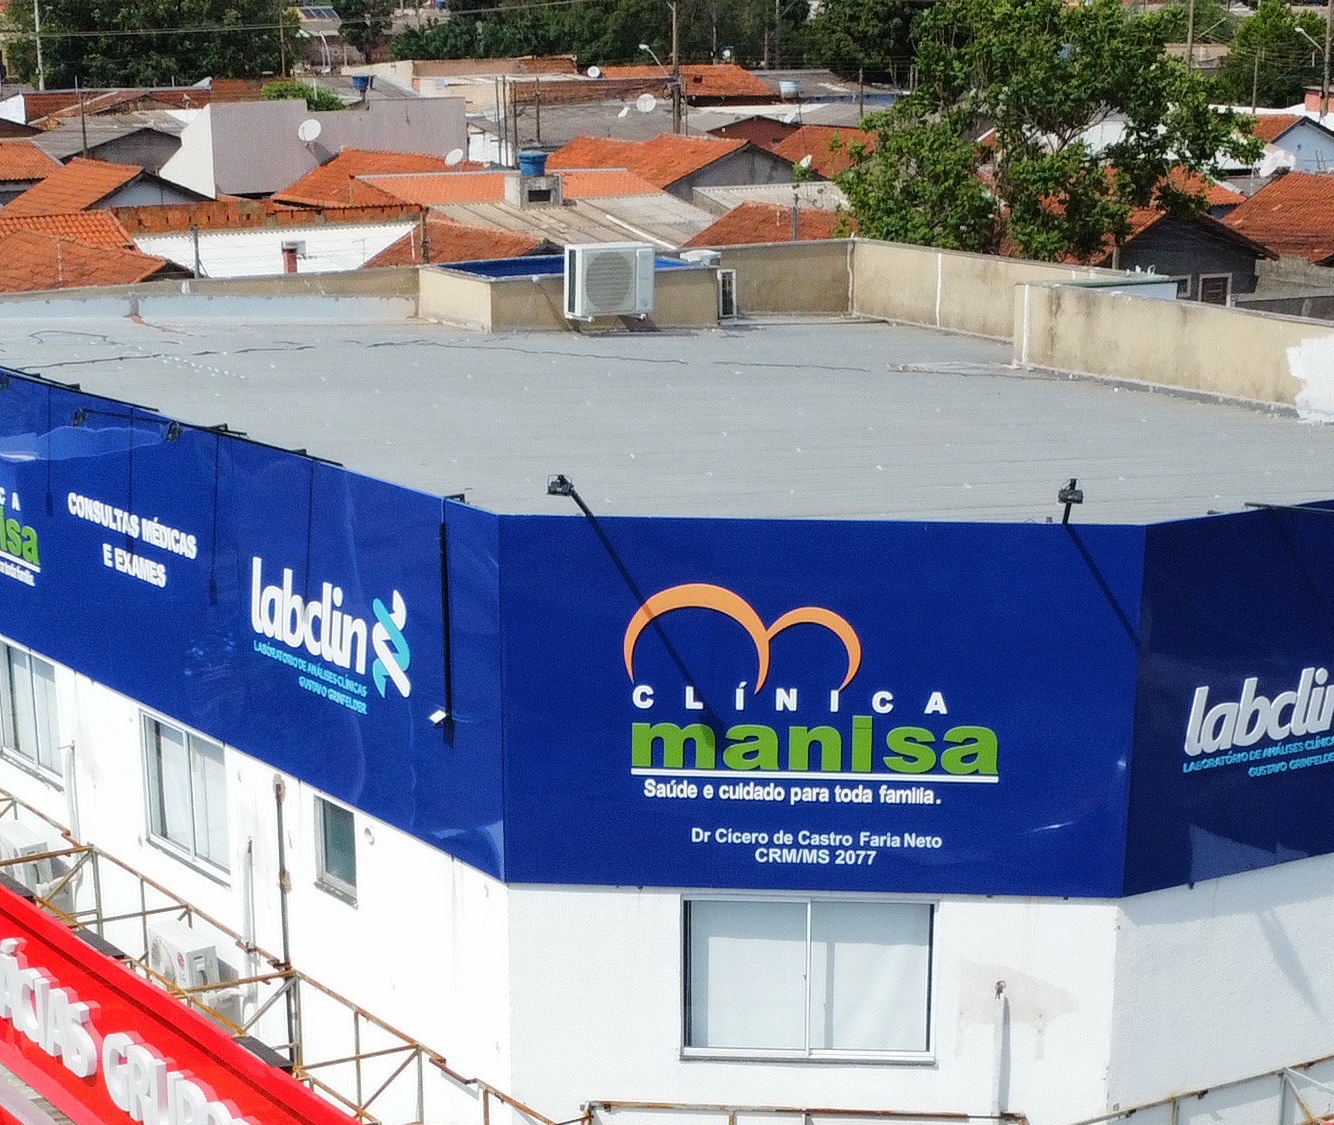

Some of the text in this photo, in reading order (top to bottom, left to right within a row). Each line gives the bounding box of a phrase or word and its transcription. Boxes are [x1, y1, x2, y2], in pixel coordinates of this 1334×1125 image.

[67, 491, 198, 560] CONSULTAS MÉDICAS
[102, 542, 167, 588] E EXAMES
[250, 556, 367, 675] labclin
[632, 681, 948, 715] CLÍNICA
[630, 715, 999, 774] manisa
[1249, 747, 1262, 761] DE
[1248, 763, 1288, 778] GUSTAVO
[643, 778, 698, 799] Saúde
[702, 783, 714, 799] e
[718, 781, 785, 801] cuidado
[790, 786, 829, 805] para
[834, 784, 873, 803] toda
[691, 827, 942, 849] Dr Cícero de Castro Faria Neto
[754, 847, 877, 865] CRM/MS 2077
